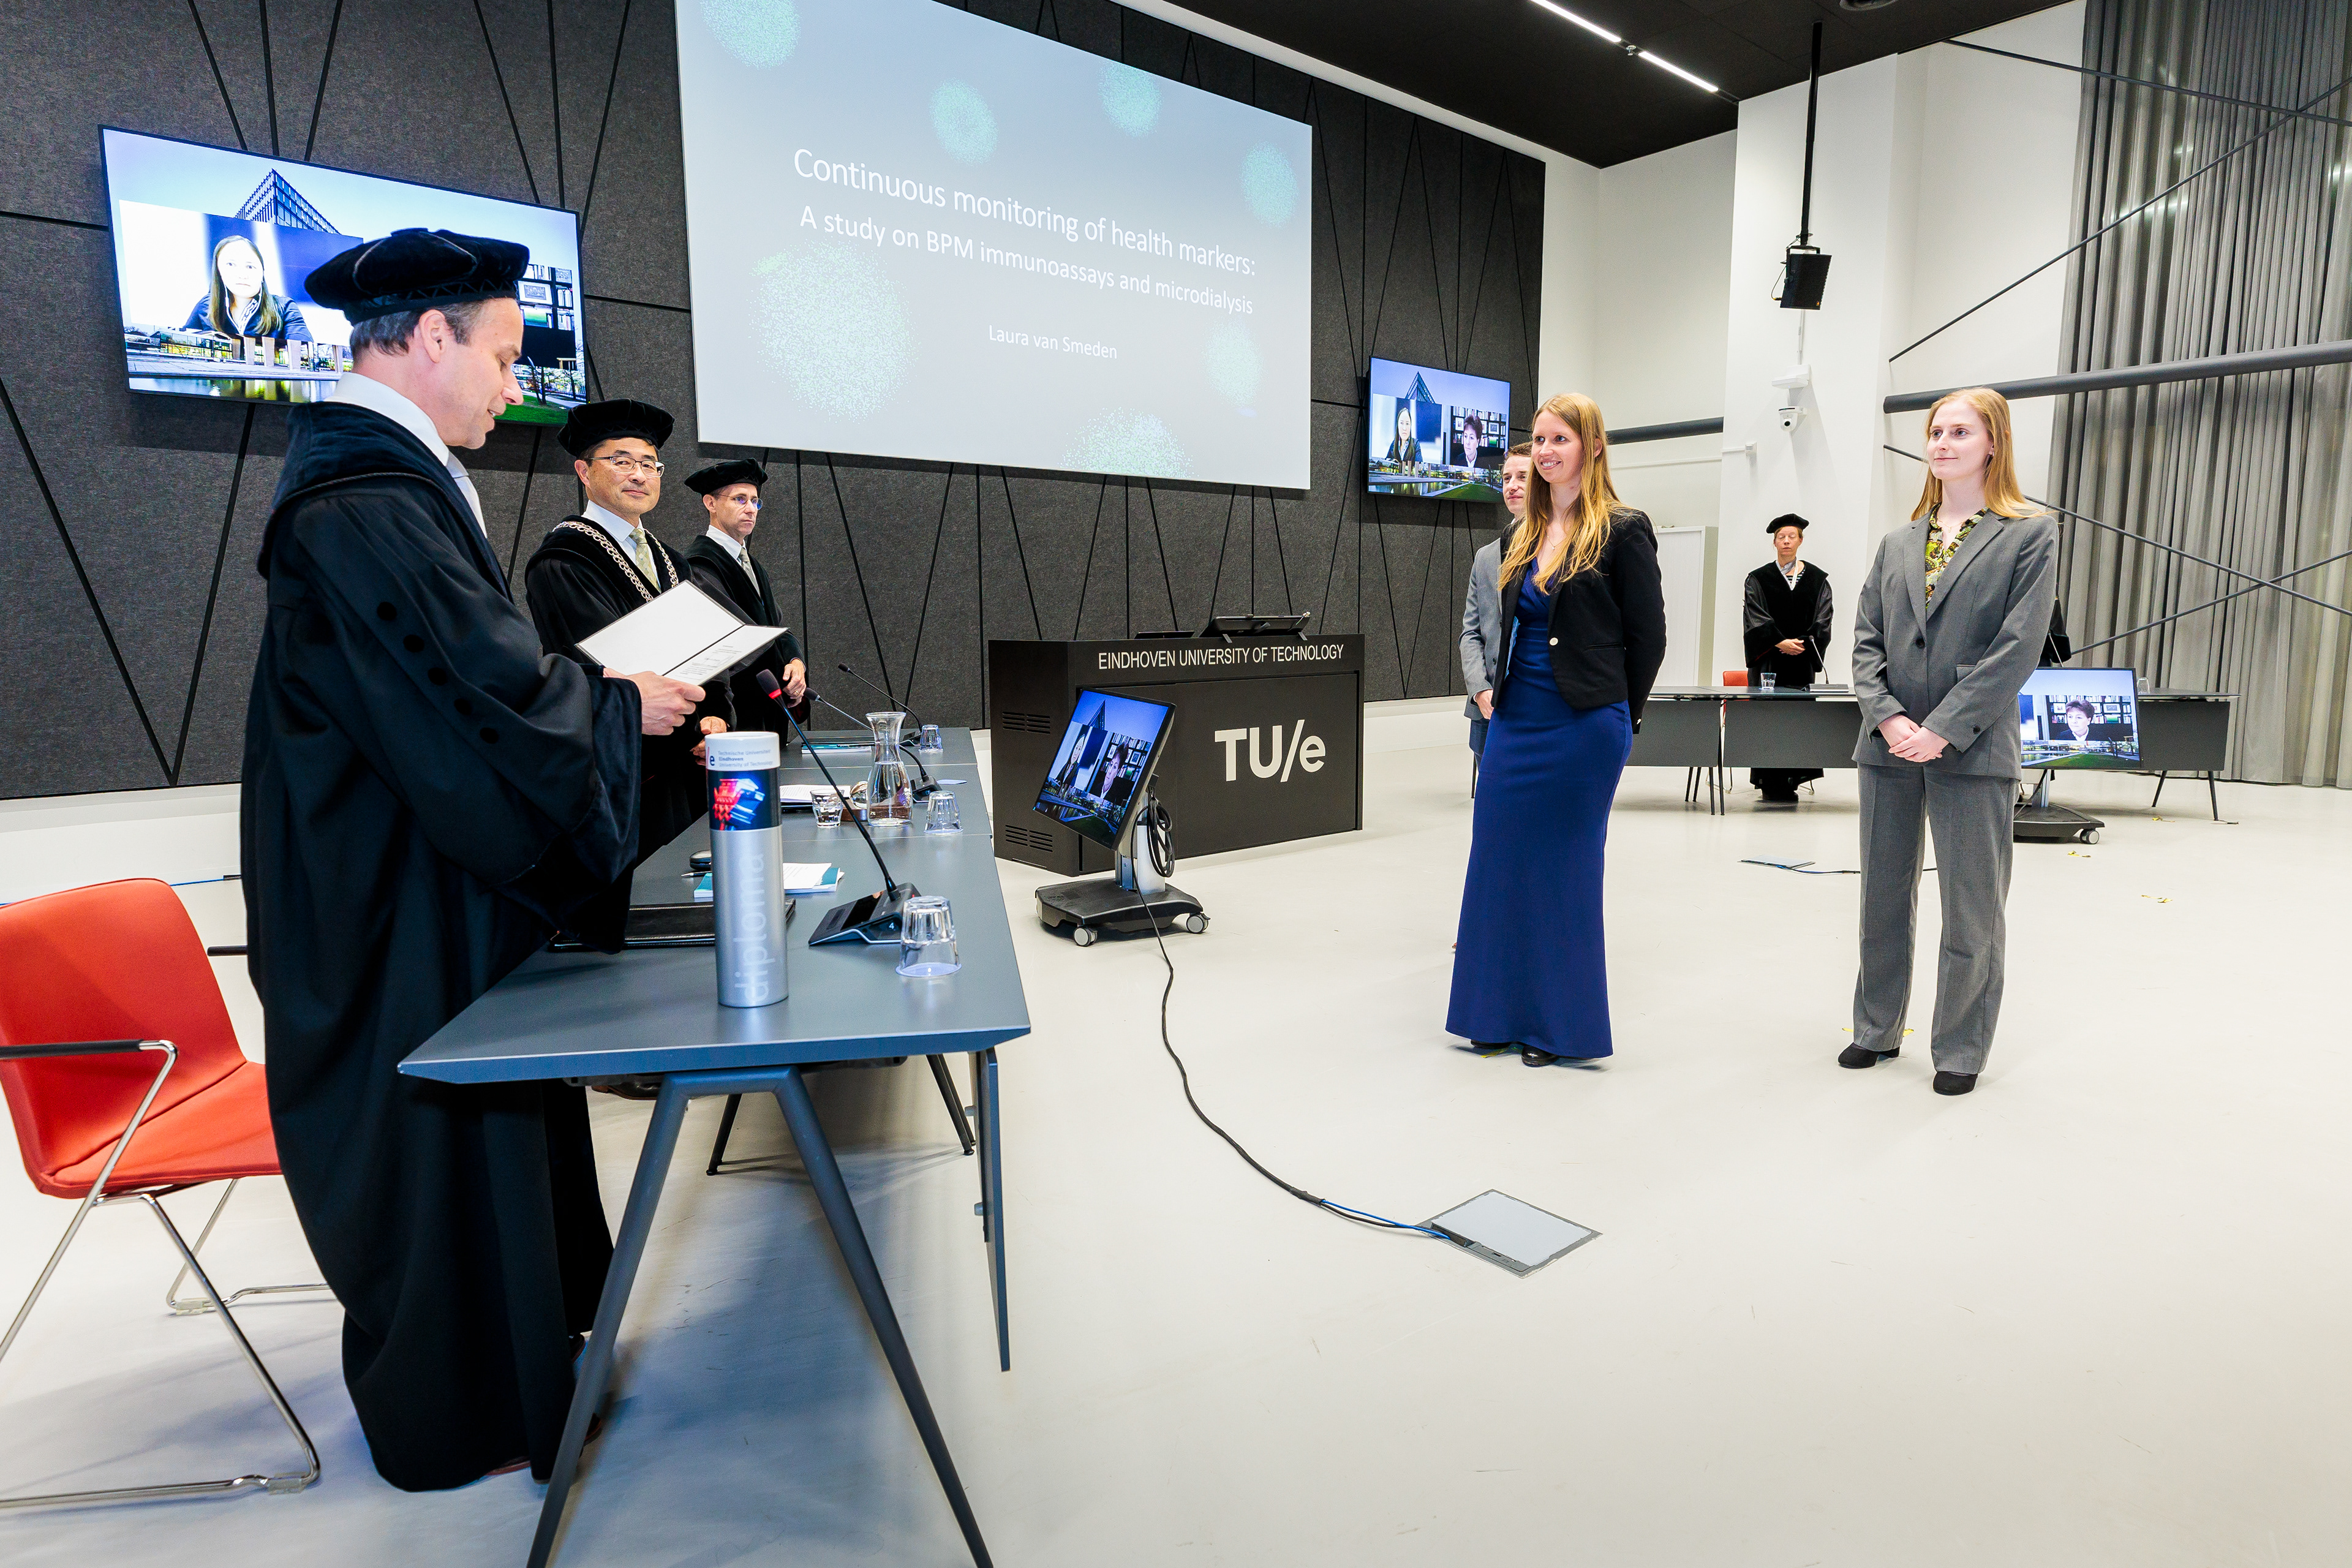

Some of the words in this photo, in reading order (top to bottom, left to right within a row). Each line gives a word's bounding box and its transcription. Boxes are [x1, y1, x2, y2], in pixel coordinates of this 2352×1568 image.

[794, 148, 946, 207] Continuous
[954, 191, 1079, 243] monitoring
[1084, 217, 1107, 243] of
[1112, 220, 1173, 258] health
[1179, 243, 1256, 276] markers:
[799, 205, 818, 230] A
[824, 213, 886, 247] study
[892, 228, 919, 249] on
[927, 230, 974, 260] BPM
[980, 241, 1115, 290] immunoassays
[1119, 274, 1150, 295] and
[1155, 280, 1253, 315] microdialysis
[989, 324, 1029, 346] Laura
[1032, 334, 1058, 350] van
[1062, 336, 1118, 360] Smeden
[1098, 650, 1175, 669] EINDHOVEN
[1179, 647, 1250, 666] UNIVERSITY
[1253, 647, 1268, 663] OF
[1270, 644, 1344, 662] TECHNOLOGY
[1214, 718, 1326, 783] TU/e
[734, 854, 775, 1003] diploma
